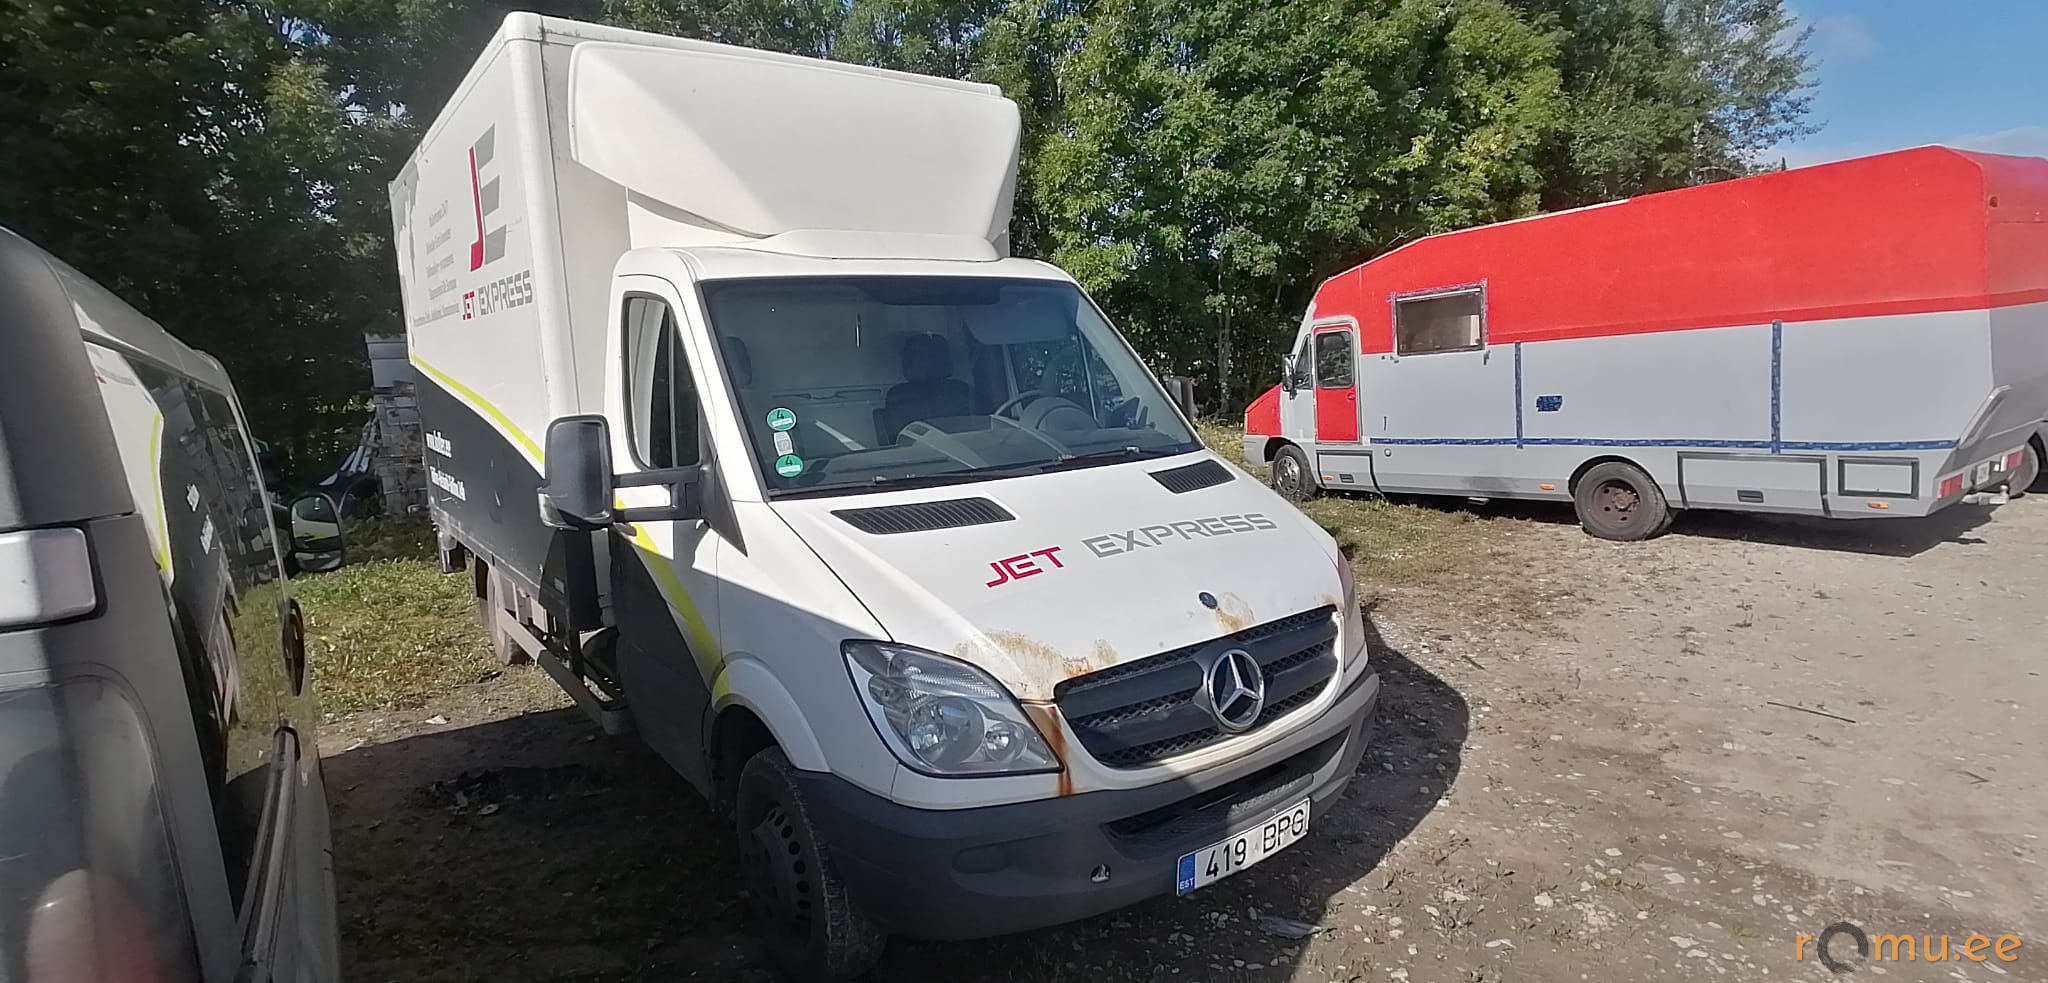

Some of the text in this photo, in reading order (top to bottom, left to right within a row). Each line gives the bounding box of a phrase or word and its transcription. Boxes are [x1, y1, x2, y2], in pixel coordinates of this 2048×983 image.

[462, 290, 476, 321] JET
[478, 269, 533, 316] EXPRESS
[776, 409, 785, 419] 4
[785, 455, 793, 465] 4
[985, 513, 1278, 588] JET EXPRESS
[1205, 808, 1305, 878] 419 BPG
[1179, 877, 1194, 890] EST
